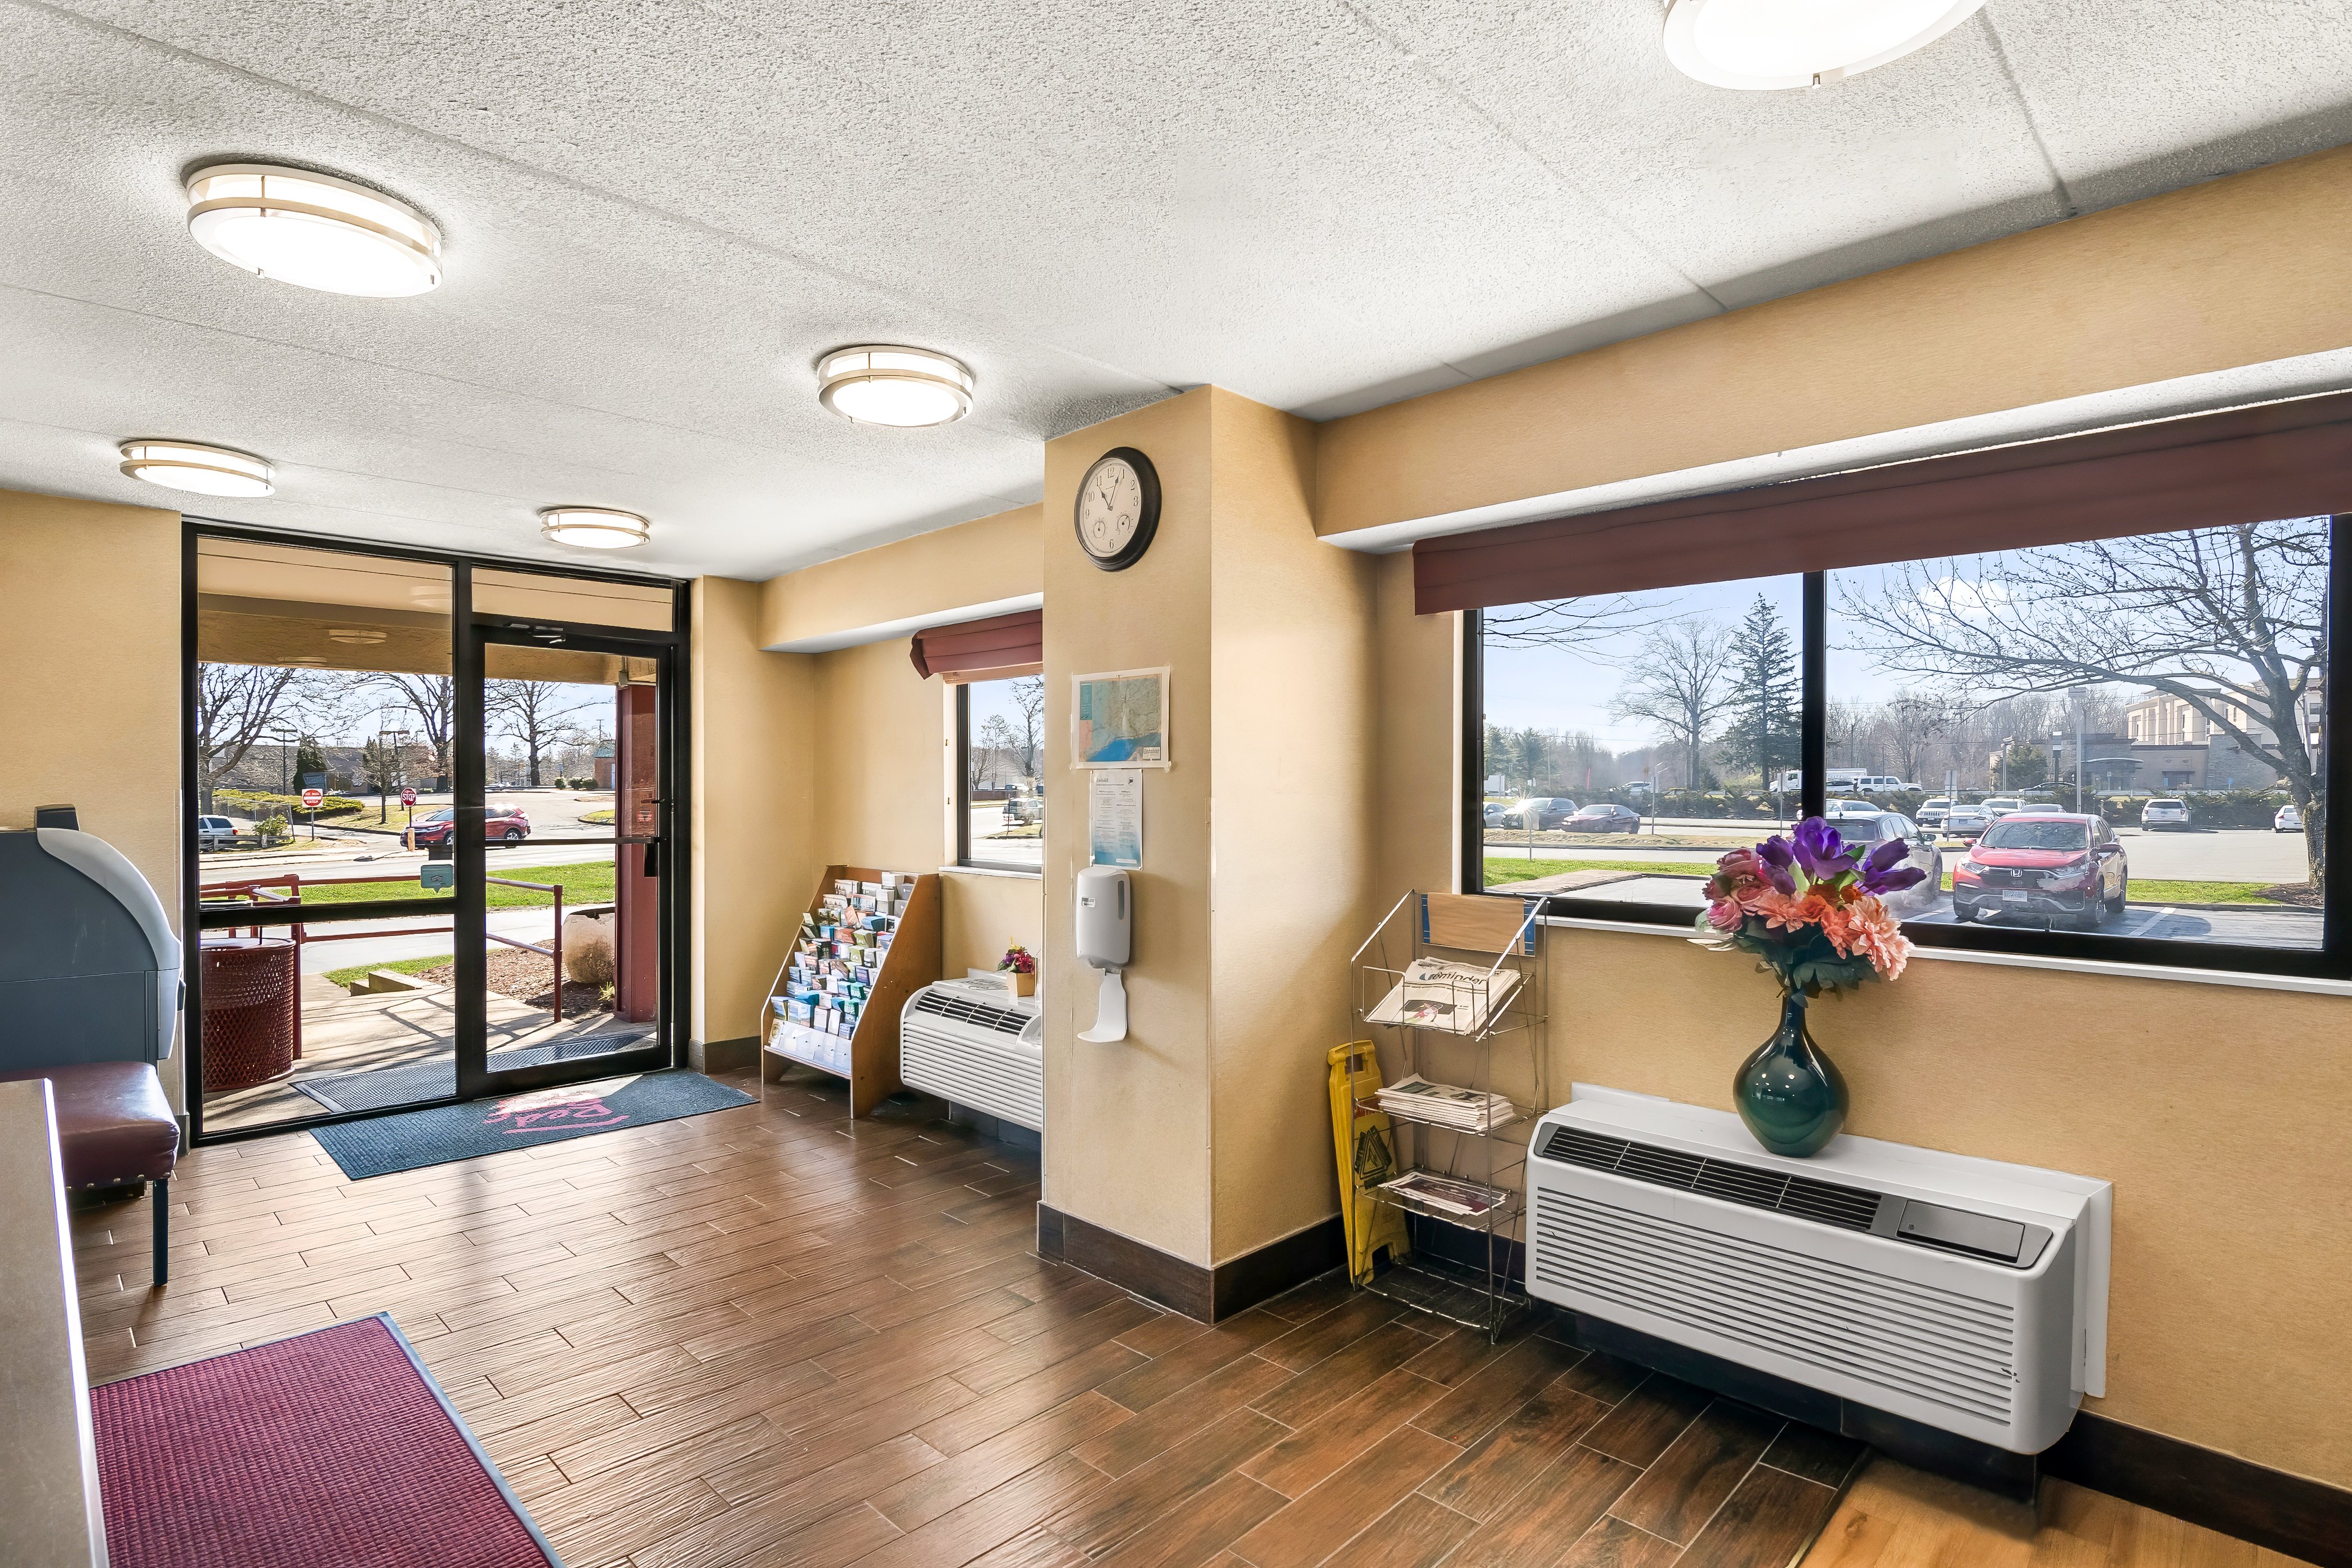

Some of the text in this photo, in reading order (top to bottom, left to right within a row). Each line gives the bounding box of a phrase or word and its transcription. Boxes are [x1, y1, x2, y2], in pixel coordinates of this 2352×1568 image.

[1107, 466, 1115, 479] 12
[1095, 475, 1102, 487] 11
[1130, 479, 1135, 491] 2
[1088, 491, 1095, 502] 10
[1133, 496, 1138, 506] 3
[1085, 508, 1090, 519] 9
[1109, 538, 1114, 550] 6
[402, 793, 416, 801] STOP
